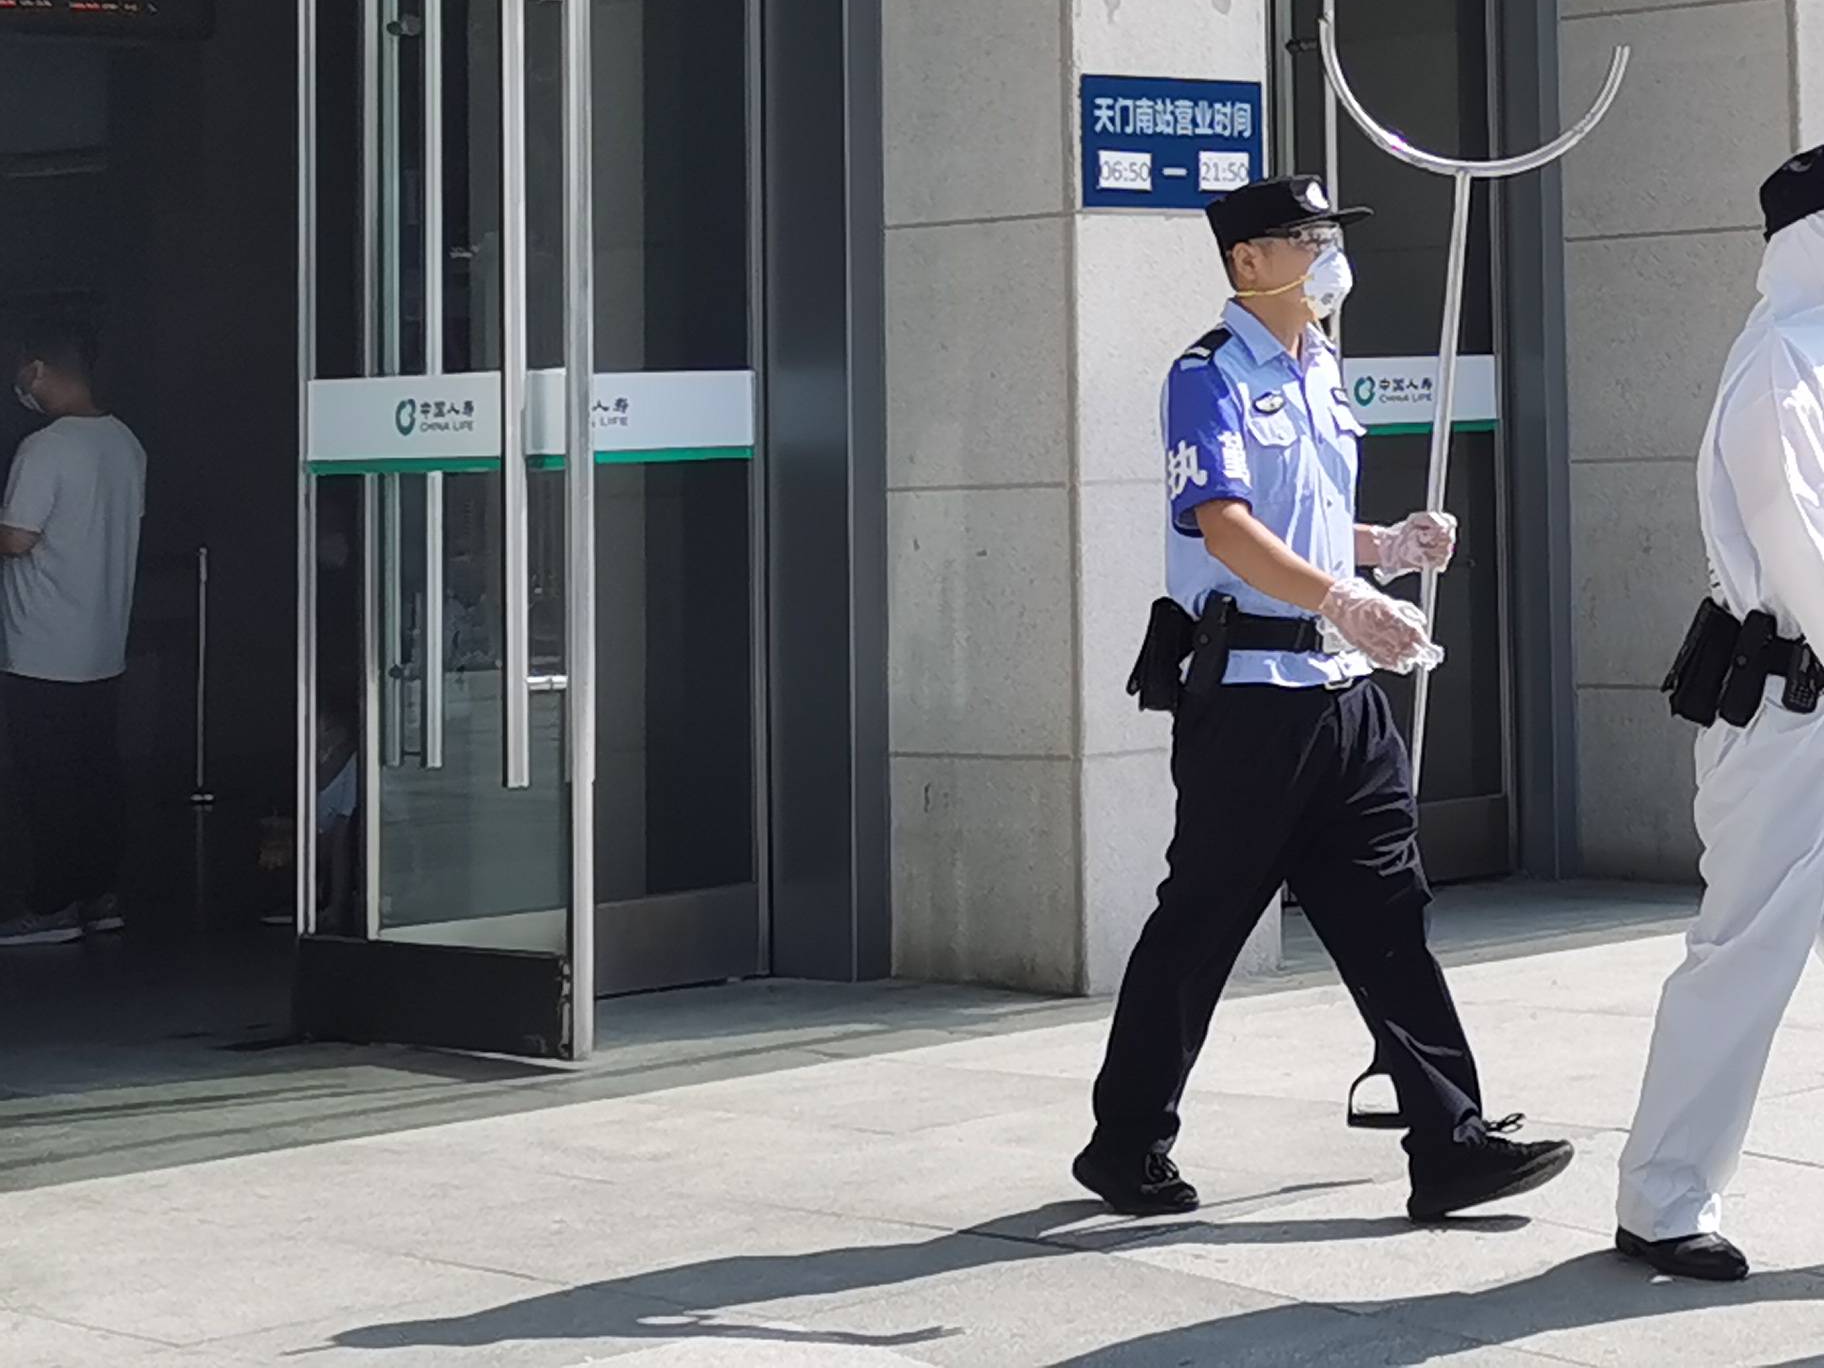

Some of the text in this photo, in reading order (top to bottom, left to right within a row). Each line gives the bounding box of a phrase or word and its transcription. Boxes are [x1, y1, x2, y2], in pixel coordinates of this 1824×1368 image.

[1094, 97, 1252, 138] 天门南站营业时间
[1101, 160, 1151, 183] 06:50
[1201, 162, 1249, 183] 21:50
